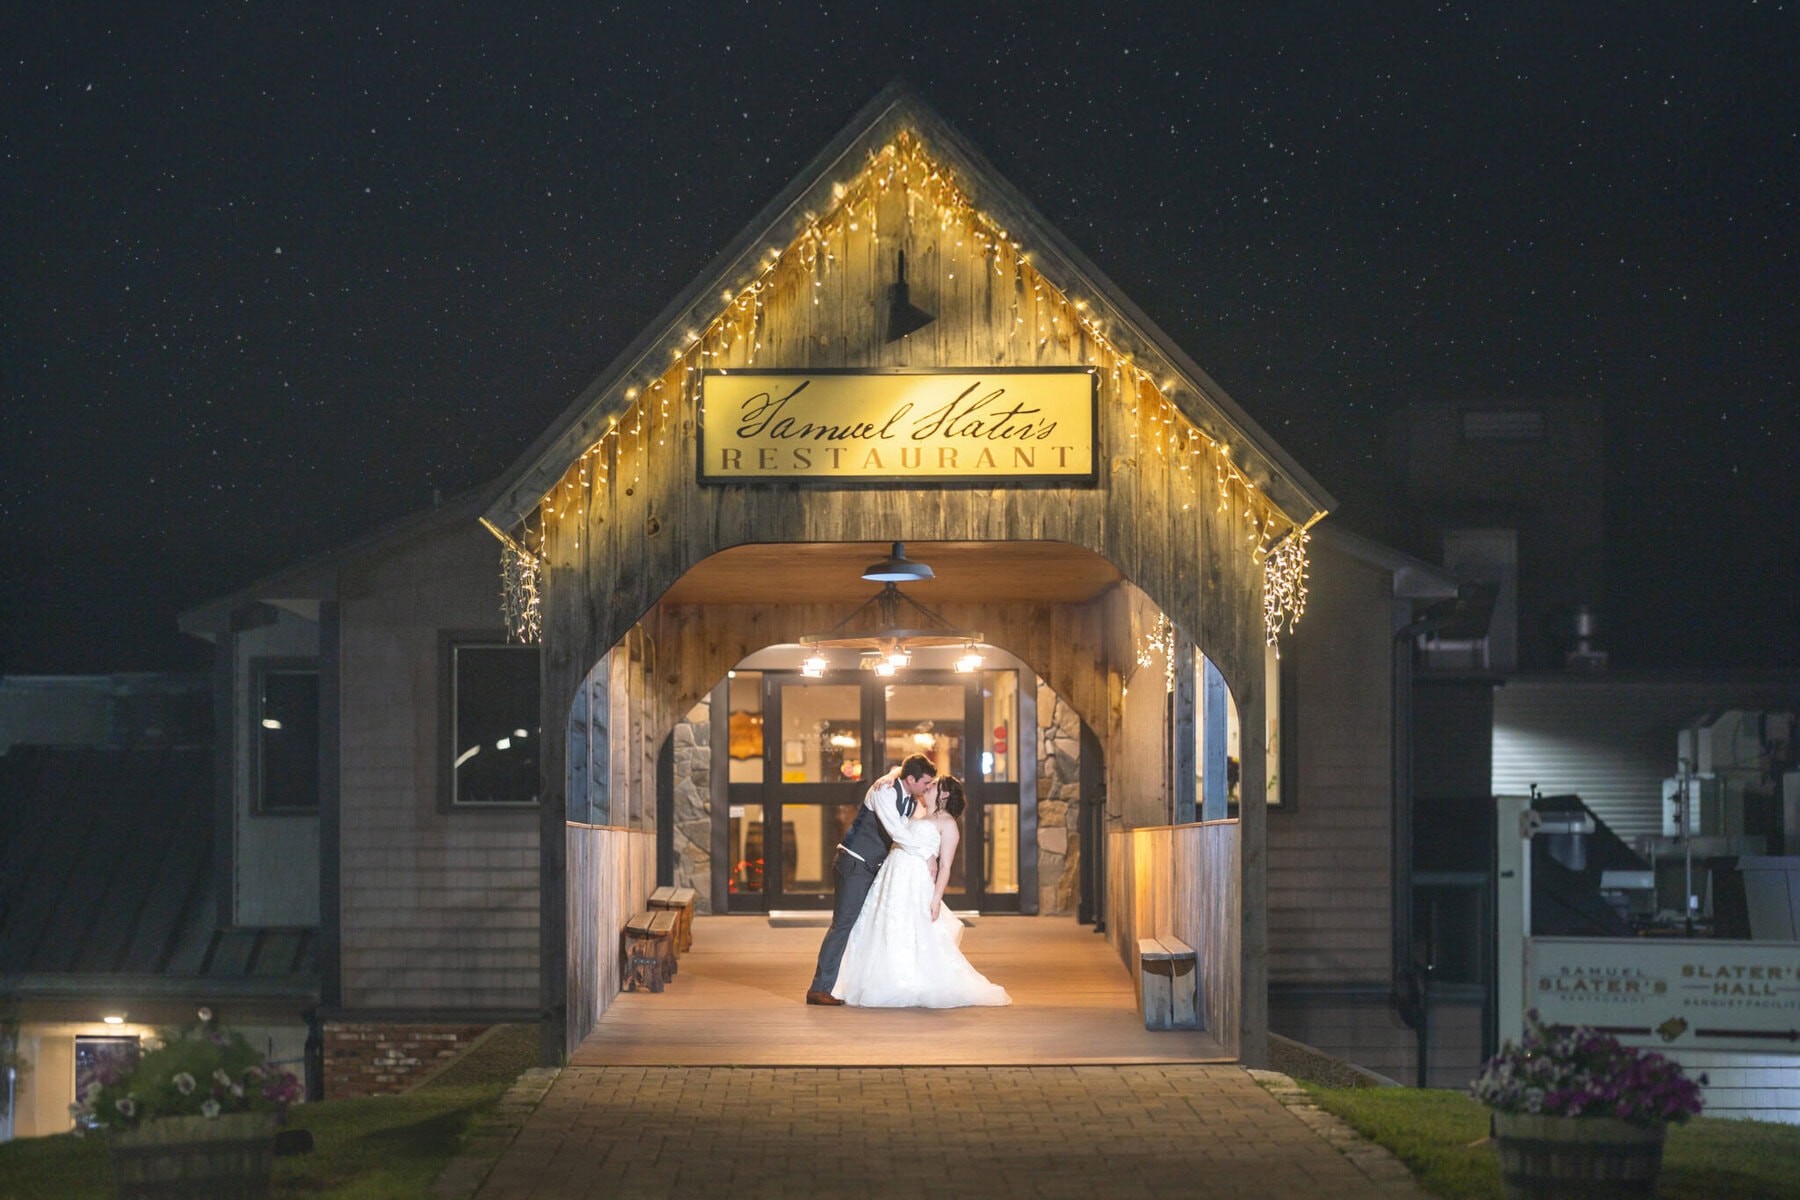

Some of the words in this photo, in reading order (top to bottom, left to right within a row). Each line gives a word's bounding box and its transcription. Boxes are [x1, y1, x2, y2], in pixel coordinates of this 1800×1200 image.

[736, 380, 914, 441] Samuel
[911, 381, 1058, 441] Slater's
[720, 446, 1074, 470] RESTAURANT
[1560, 966, 1644, 978] SAMUEL
[1538, 978, 1668, 994] SLATER'S
[1713, 983, 1777, 996] HALL
